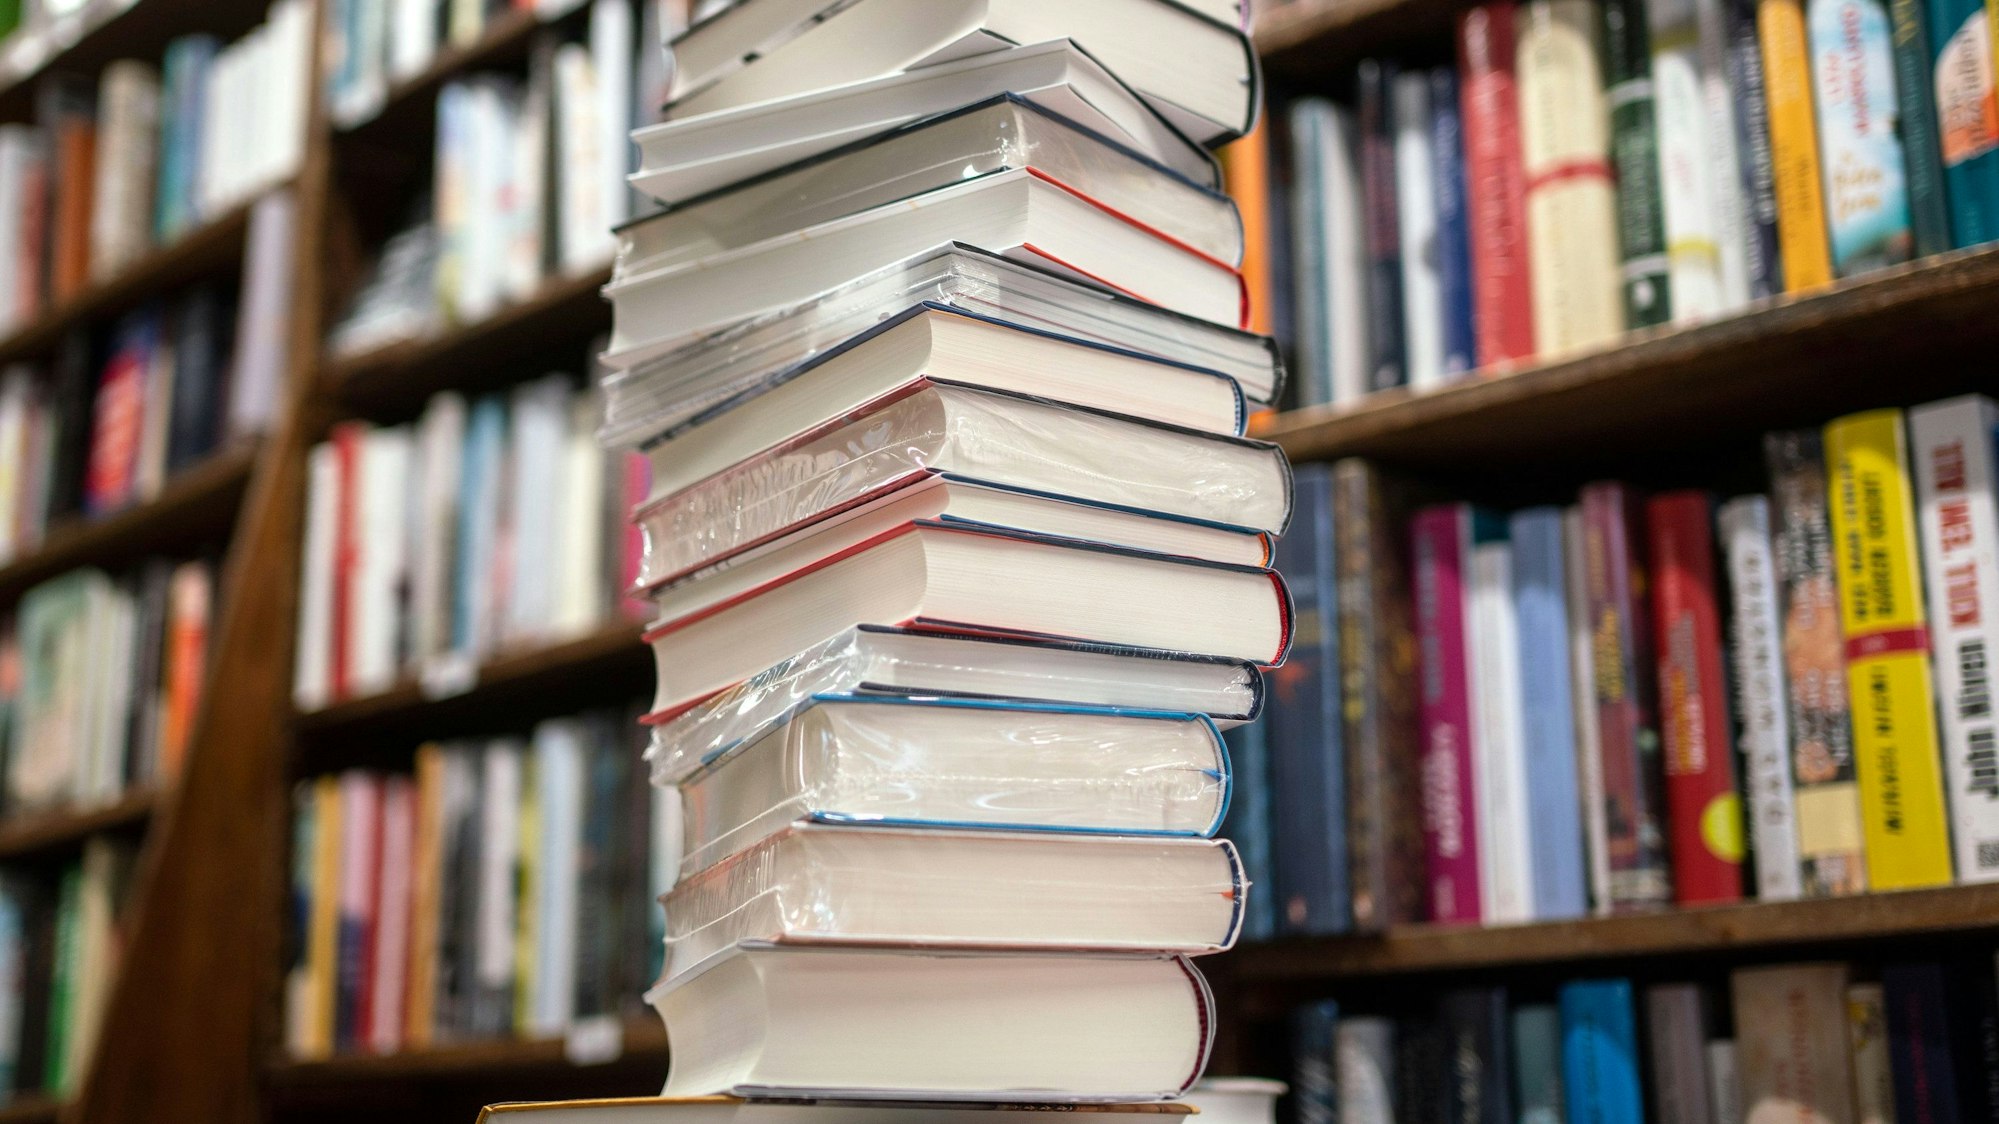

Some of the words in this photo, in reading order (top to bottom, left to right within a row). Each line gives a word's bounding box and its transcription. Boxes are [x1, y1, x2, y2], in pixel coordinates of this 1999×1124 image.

[1932, 438, 1967, 492] ALL
[1946, 562, 1981, 629] KILL
[1957, 640, 1991, 718] Niven
[1966, 729, 1998, 799] John
